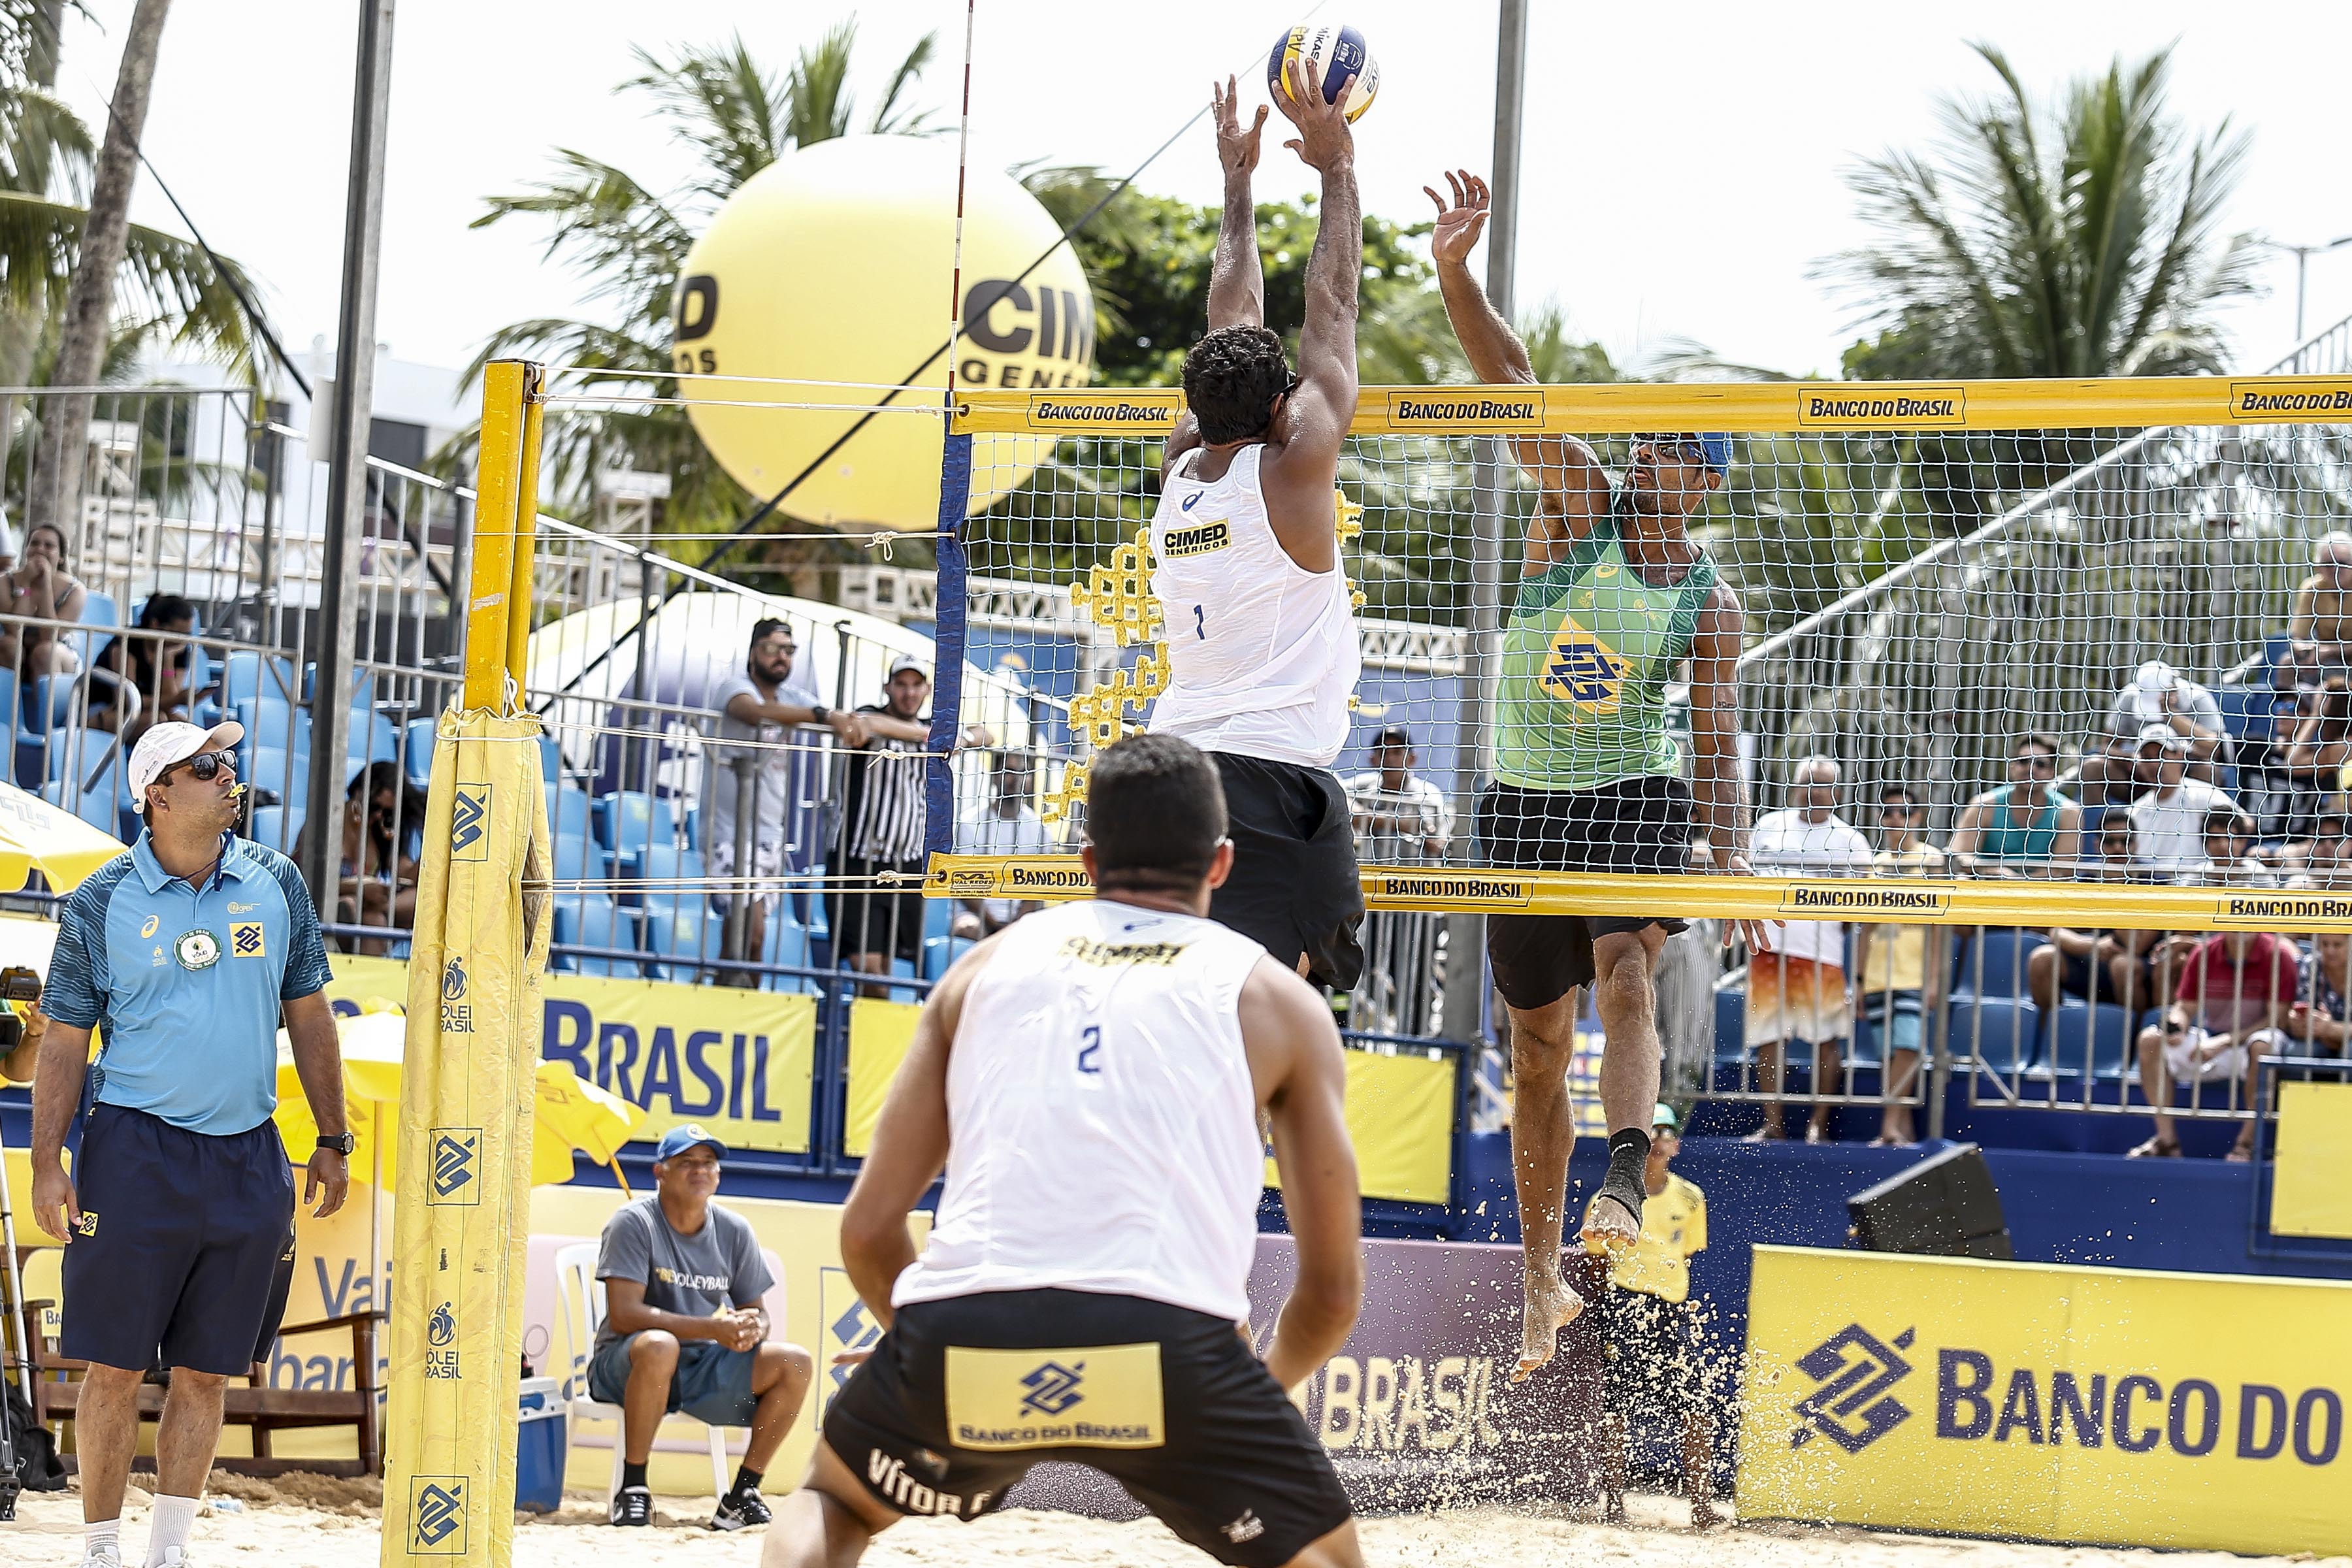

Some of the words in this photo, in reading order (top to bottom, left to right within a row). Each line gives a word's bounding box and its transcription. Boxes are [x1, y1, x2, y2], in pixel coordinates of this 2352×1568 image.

[1398, 400, 1455, 419] BANCO
[1456, 403, 1478, 419] DO
[1479, 400, 1535, 419] BRASIL
[1810, 398, 1870, 417] BANCO
[1871, 400, 1895, 417] DO
[1896, 397, 1955, 417] BRASIL
[2242, 393, 2306, 410] BANCO
[2306, 394, 2333, 410] DO
[1037, 402, 1092, 419] BANCO
[1093, 406, 1115, 420] DO
[1115, 403, 1168, 421] BRASIL
[1164, 523, 1227, 548] CIMED
[1165, 538, 1228, 555] GENÉRICOS
[1193, 604, 1205, 640] 1
[1012, 868, 1068, 887] BANCO
[1068, 872, 1091, 887] DO
[1385, 878, 1442, 895] BANCO
[1443, 881, 1467, 896] DO
[1467, 880, 1522, 898] BRASIL
[1794, 889, 1854, 906] BANCO
[1854, 892, 1881, 907] DO
[1881, 890, 1939, 908] BRASIL
[2230, 899, 2293, 916] BANCO
[2295, 902, 2319, 917] DO
[441, 1002, 471, 1019] ÔLEI
[441, 1019, 475, 1033] RASIL
[1078, 1026, 1100, 1073] 2
[542, 1000, 781, 1121] BRASIL
[426, 1348, 459, 1365] ÔLEI
[425, 1365, 463, 1379] RASIL
[1320, 1355, 1501, 1450] BRASIL
[1935, 1348, 2221, 1457] BANCO
[2236, 1382, 2344, 1467] DO
[958, 1425, 1037, 1441] BANCO
[1041, 1426, 1071, 1437] DO
[1075, 1422, 1150, 1439] BRASIL
[868, 1448, 962, 1515] VÍTOR
